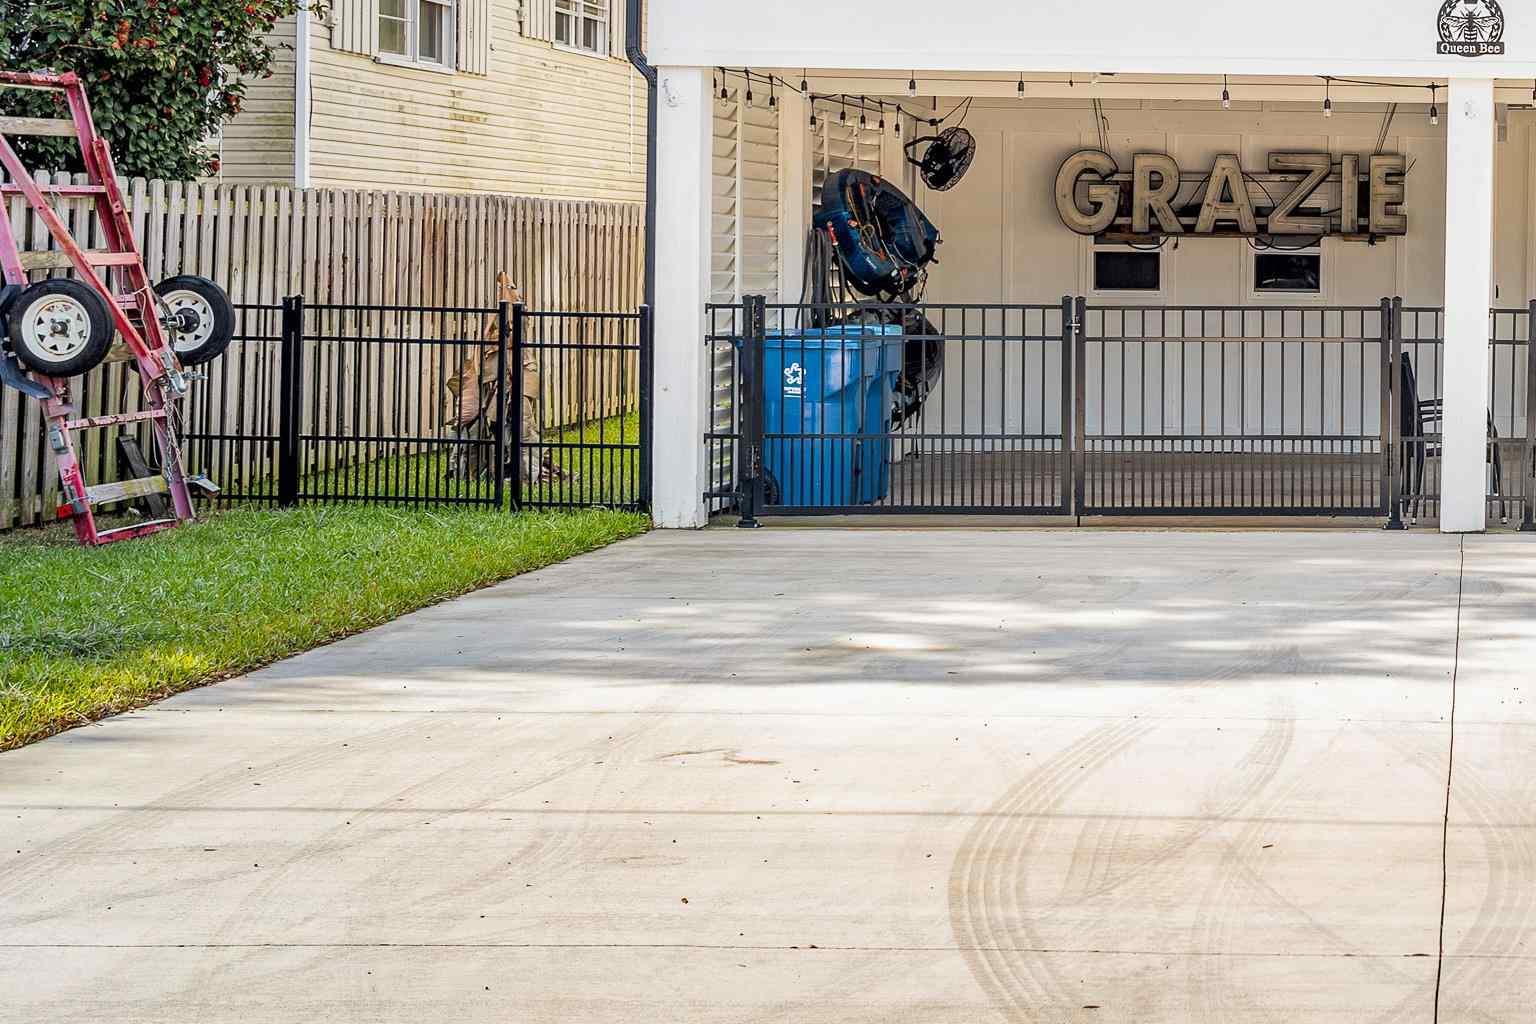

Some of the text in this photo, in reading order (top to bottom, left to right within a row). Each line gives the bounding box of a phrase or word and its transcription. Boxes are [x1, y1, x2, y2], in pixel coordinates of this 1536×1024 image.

[1440, 43, 1501, 54] Queen Bee
[1055, 149, 1407, 235] GRAZIE
